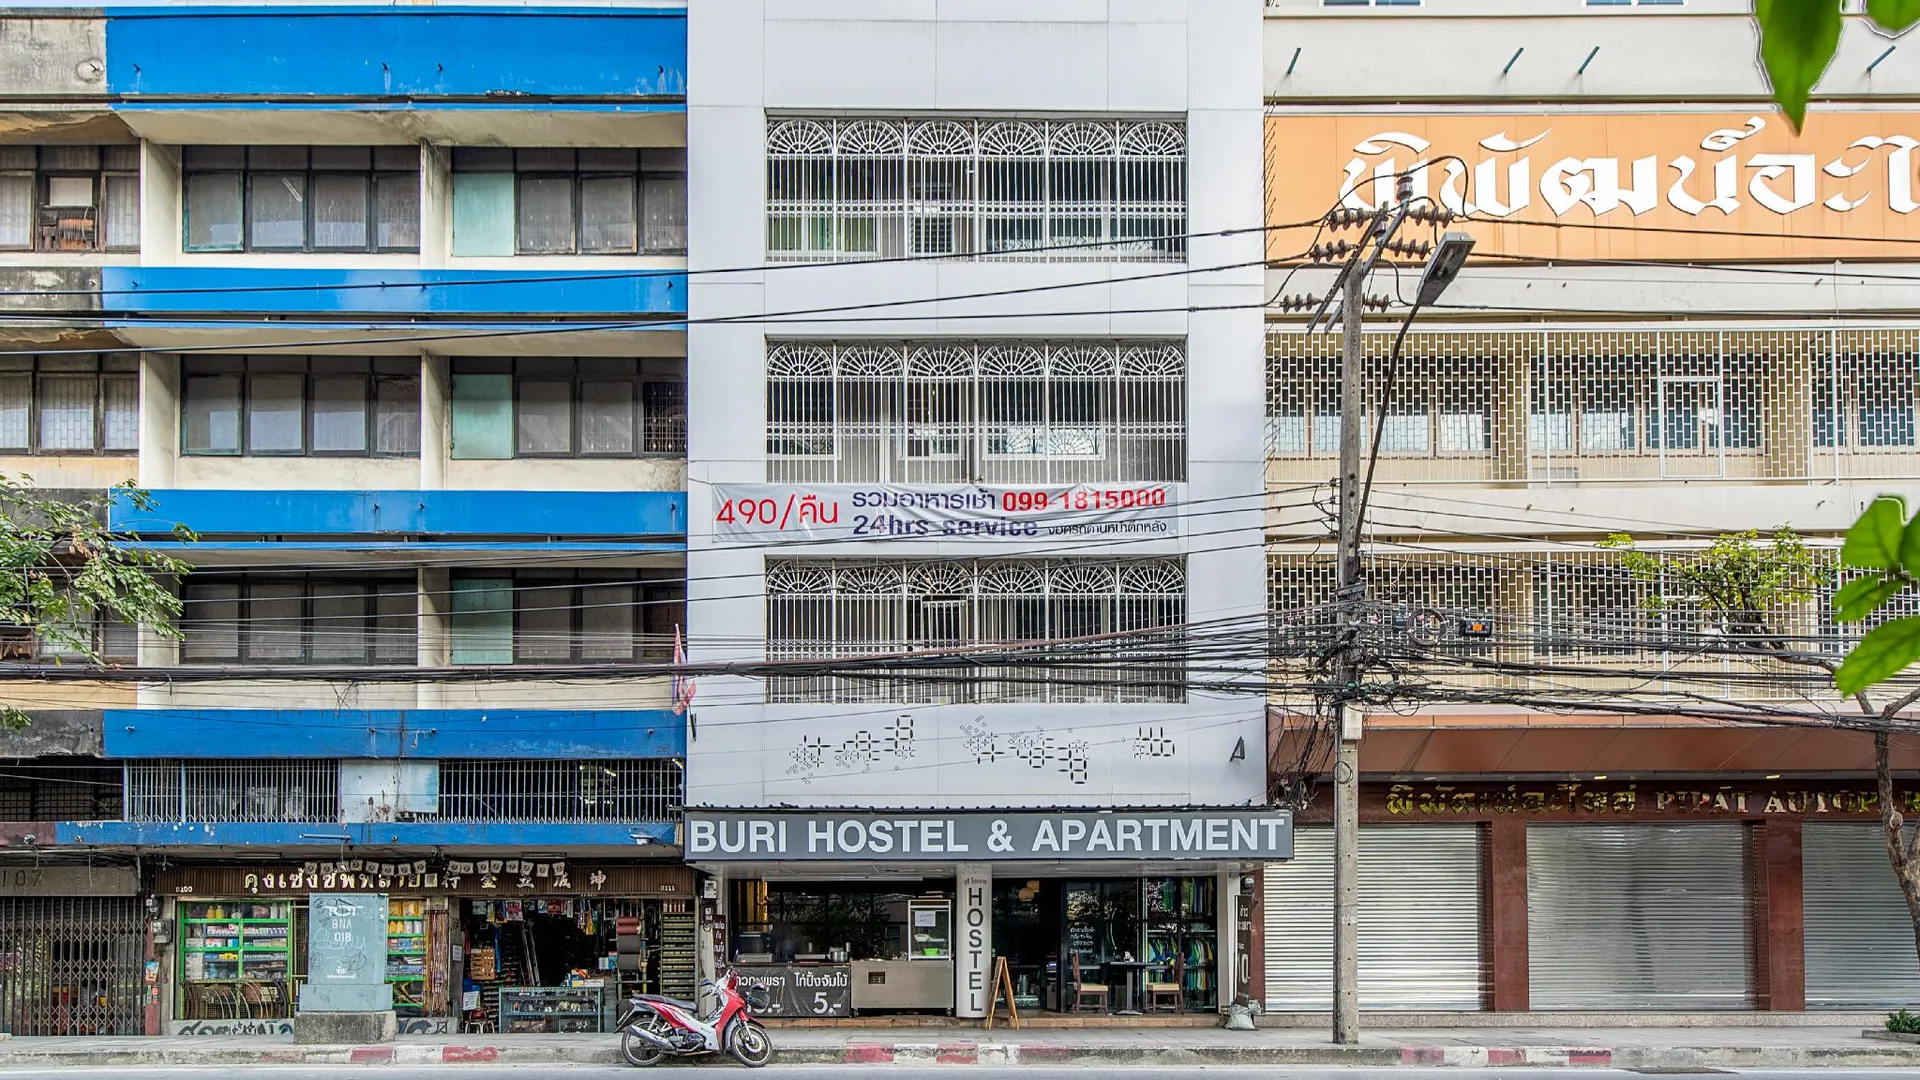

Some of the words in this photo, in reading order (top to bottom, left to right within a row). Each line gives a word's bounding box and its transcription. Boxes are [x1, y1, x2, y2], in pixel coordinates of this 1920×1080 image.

[852, 488, 996, 512] รวมอาหารเช้า
[1002, 488, 1166, 512] 099-1815000
[852, 514, 929, 535] 24hrs
[942, 516, 1038, 536] service
[1654, 791, 1752, 813] PIPAT
[690, 820, 787, 852] BURI
[808, 819, 969, 852] HOSTEL
[986, 819, 1015, 852] &
[1031, 818, 1285, 852] APARTMENT
[332, 919, 352, 929] BNA
[966, 887, 983, 1012] HOSTEL
[813, 991, 842, 1014] 5.-
